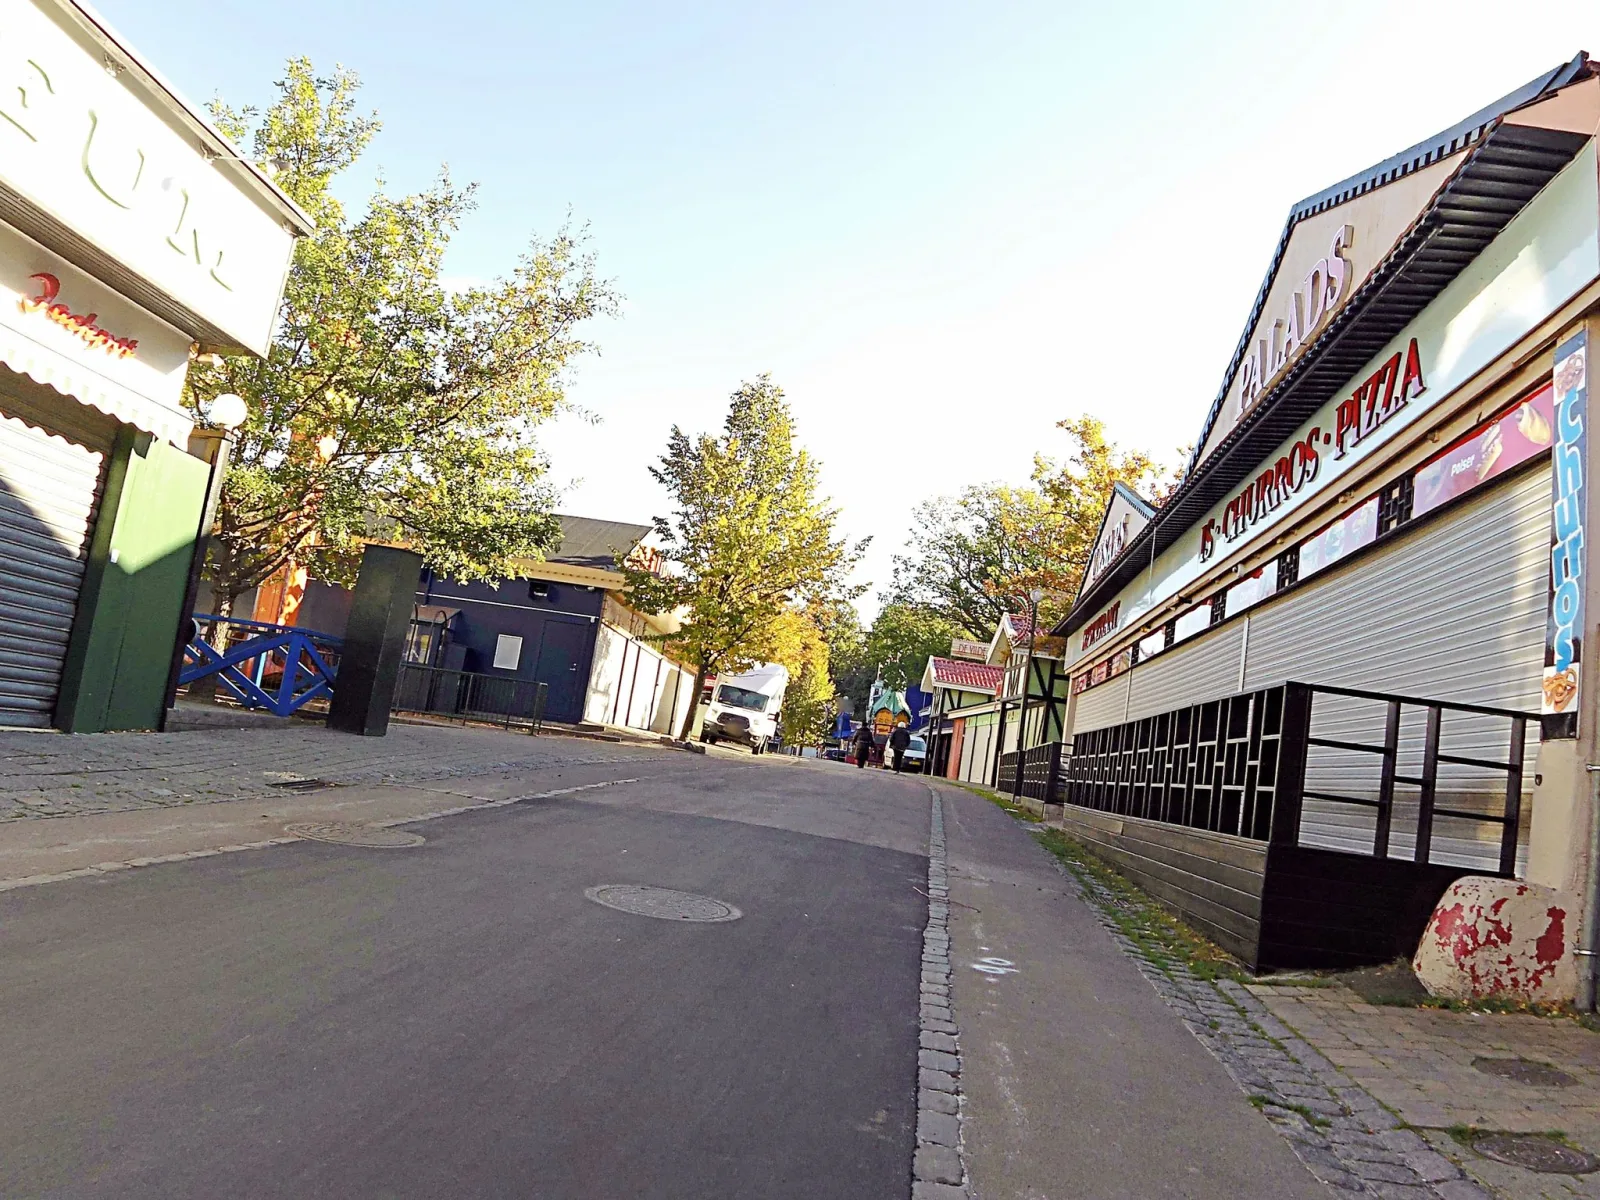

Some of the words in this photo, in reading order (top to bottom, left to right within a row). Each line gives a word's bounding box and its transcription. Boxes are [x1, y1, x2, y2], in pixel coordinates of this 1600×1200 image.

[1236, 224, 1354, 421] PALADS
[1200, 518, 1215, 563] IS
[1222, 427, 1320, 543] CHURROS
[1334, 338, 1426, 460] PIZZA
